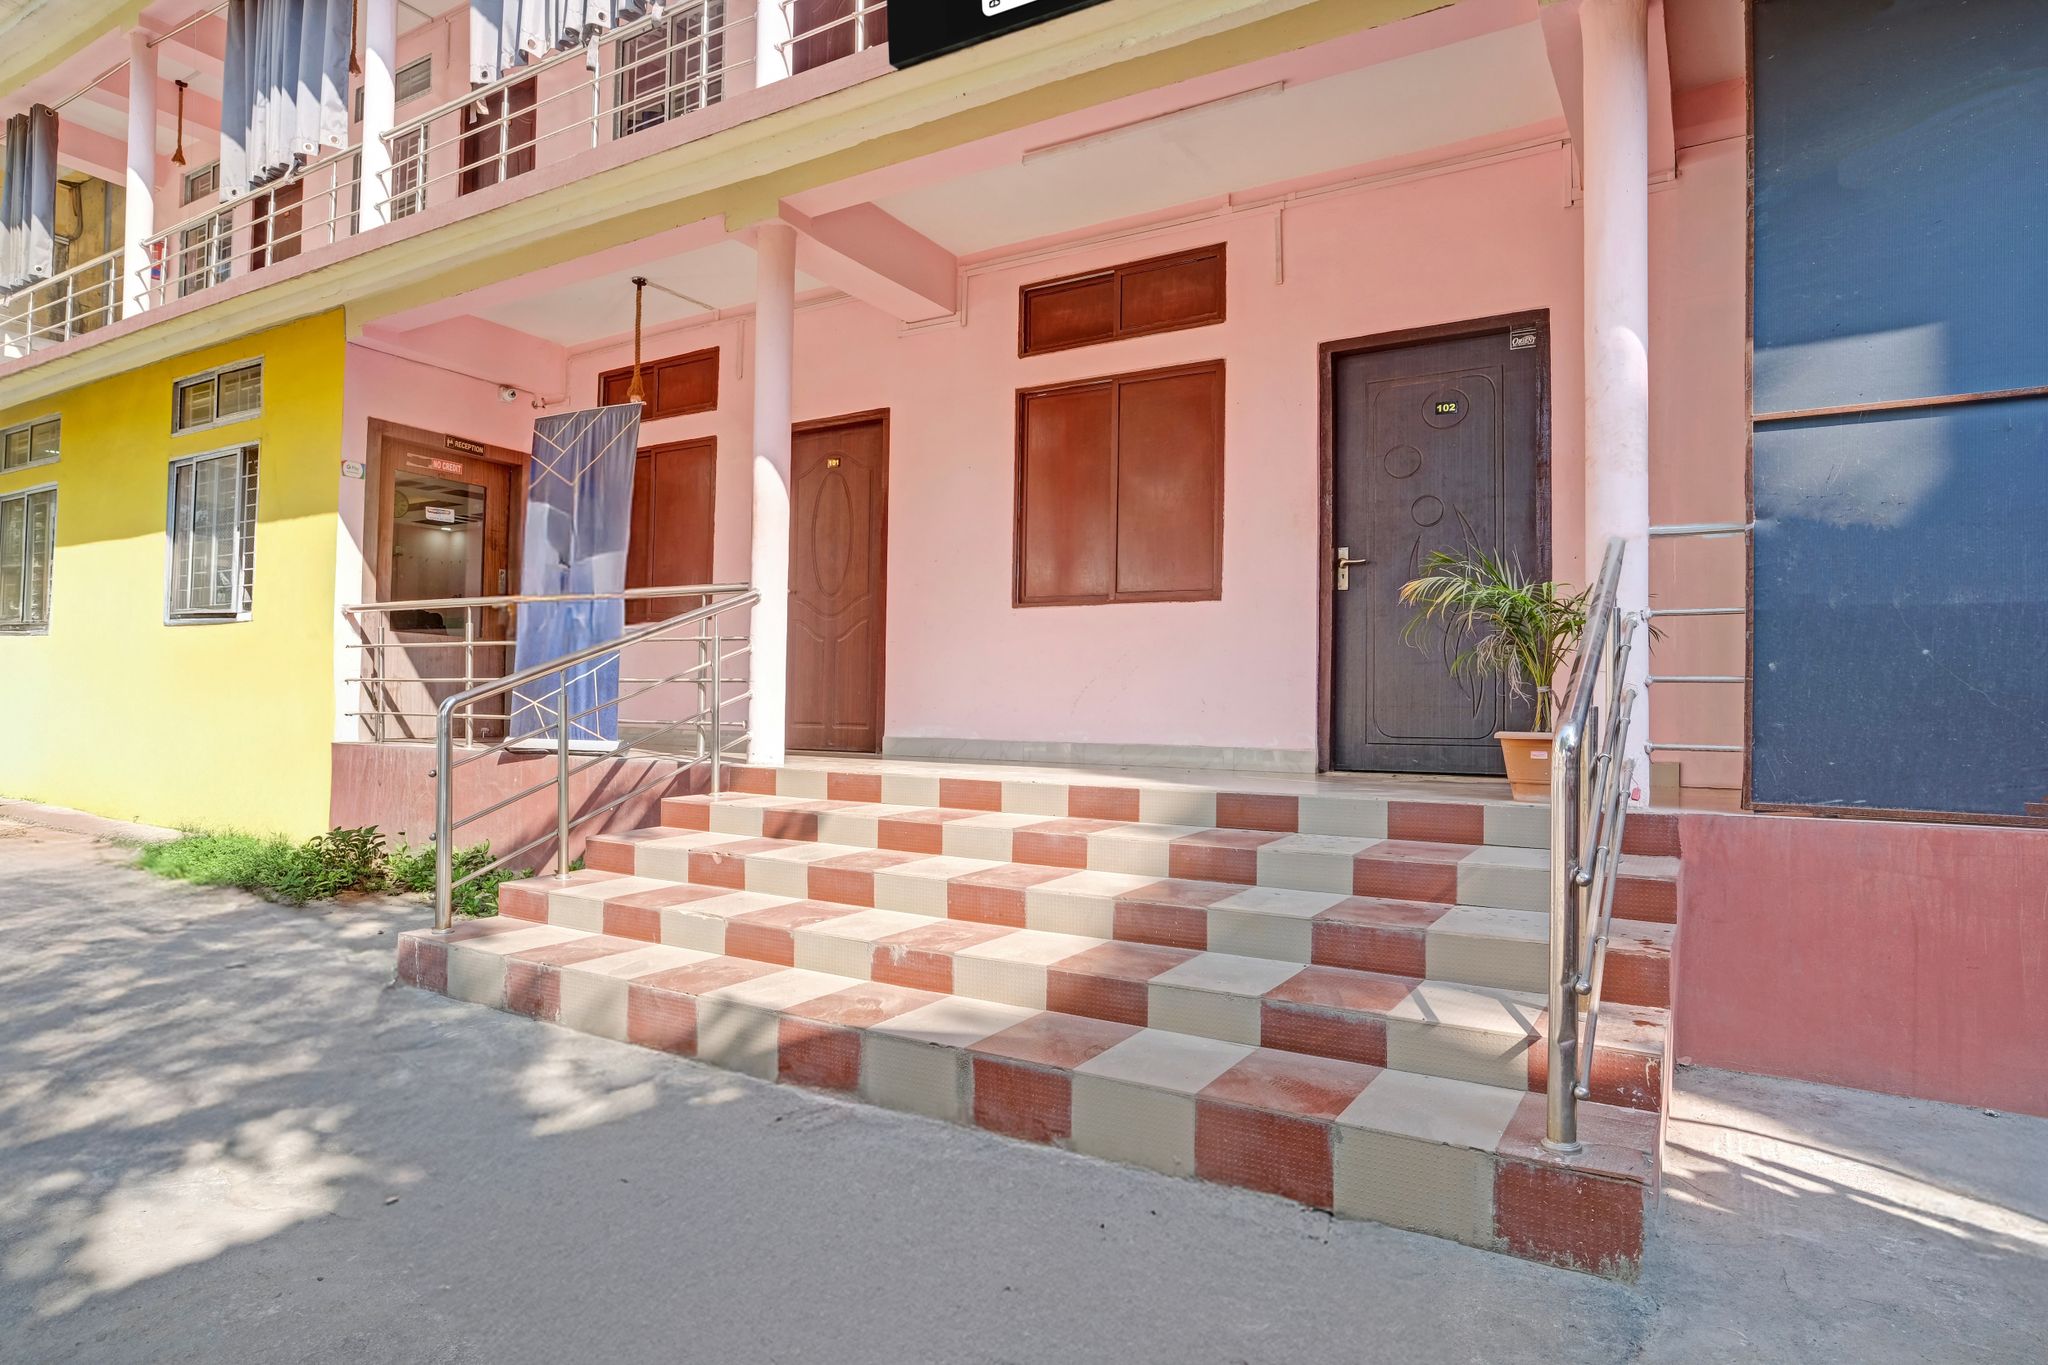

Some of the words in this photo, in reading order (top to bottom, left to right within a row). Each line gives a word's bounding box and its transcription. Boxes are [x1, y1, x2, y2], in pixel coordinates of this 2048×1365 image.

[1436, 403, 1456, 413] 102
[454, 440, 484, 454] RECEPTION
[433, 459, 442, 470] NO
[442, 461, 462, 474] CREDIT
